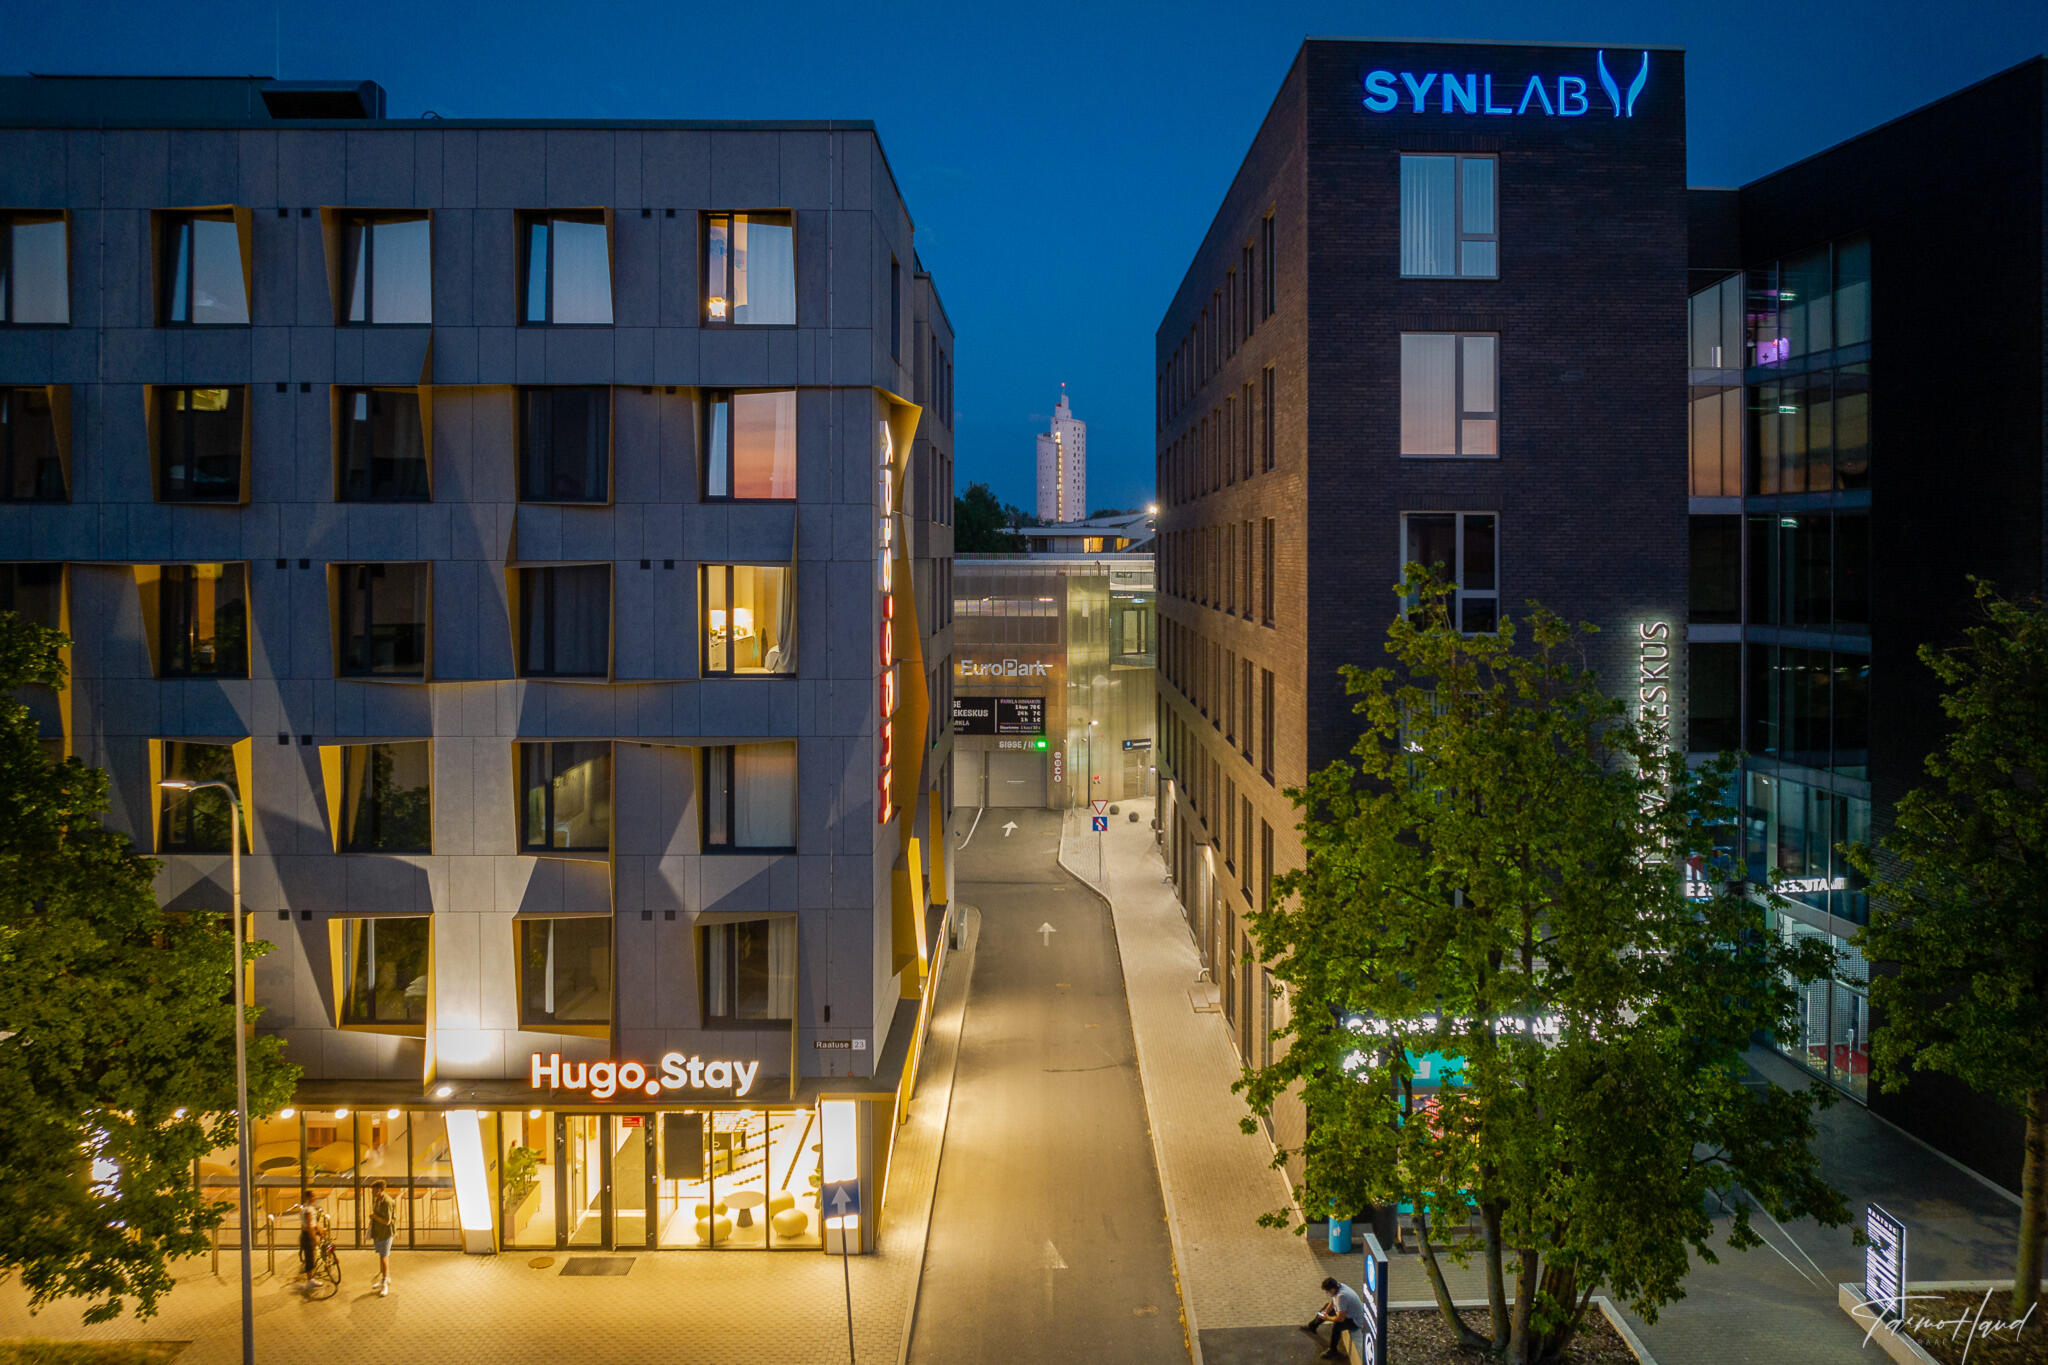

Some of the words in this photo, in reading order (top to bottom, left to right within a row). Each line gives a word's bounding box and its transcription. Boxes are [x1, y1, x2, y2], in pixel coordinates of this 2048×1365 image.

[1363, 70, 1588, 116] SYNLAB
[961, 658, 1047, 677] EuroPark
[816, 1041, 850, 1049] Raatuse
[854, 1041, 865, 1049] 23
[531, 1052, 760, 1098] Hugo.Stay
